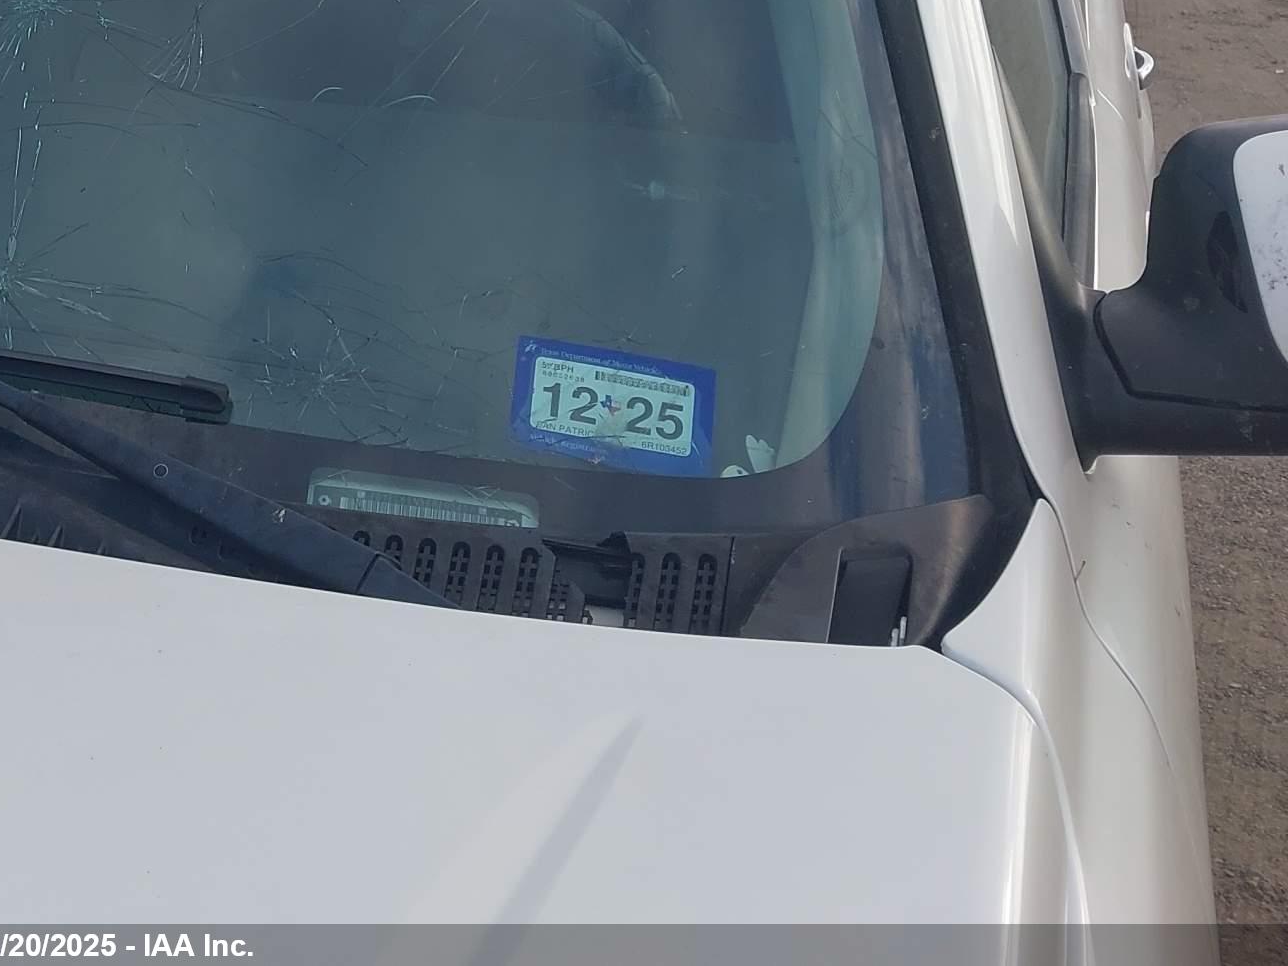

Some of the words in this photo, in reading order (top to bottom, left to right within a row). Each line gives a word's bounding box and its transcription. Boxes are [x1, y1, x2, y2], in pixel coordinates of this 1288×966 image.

[542, 382, 599, 425] 12
[625, 396, 685, 440] 25
[641, 440, 688, 456] 6R103452
